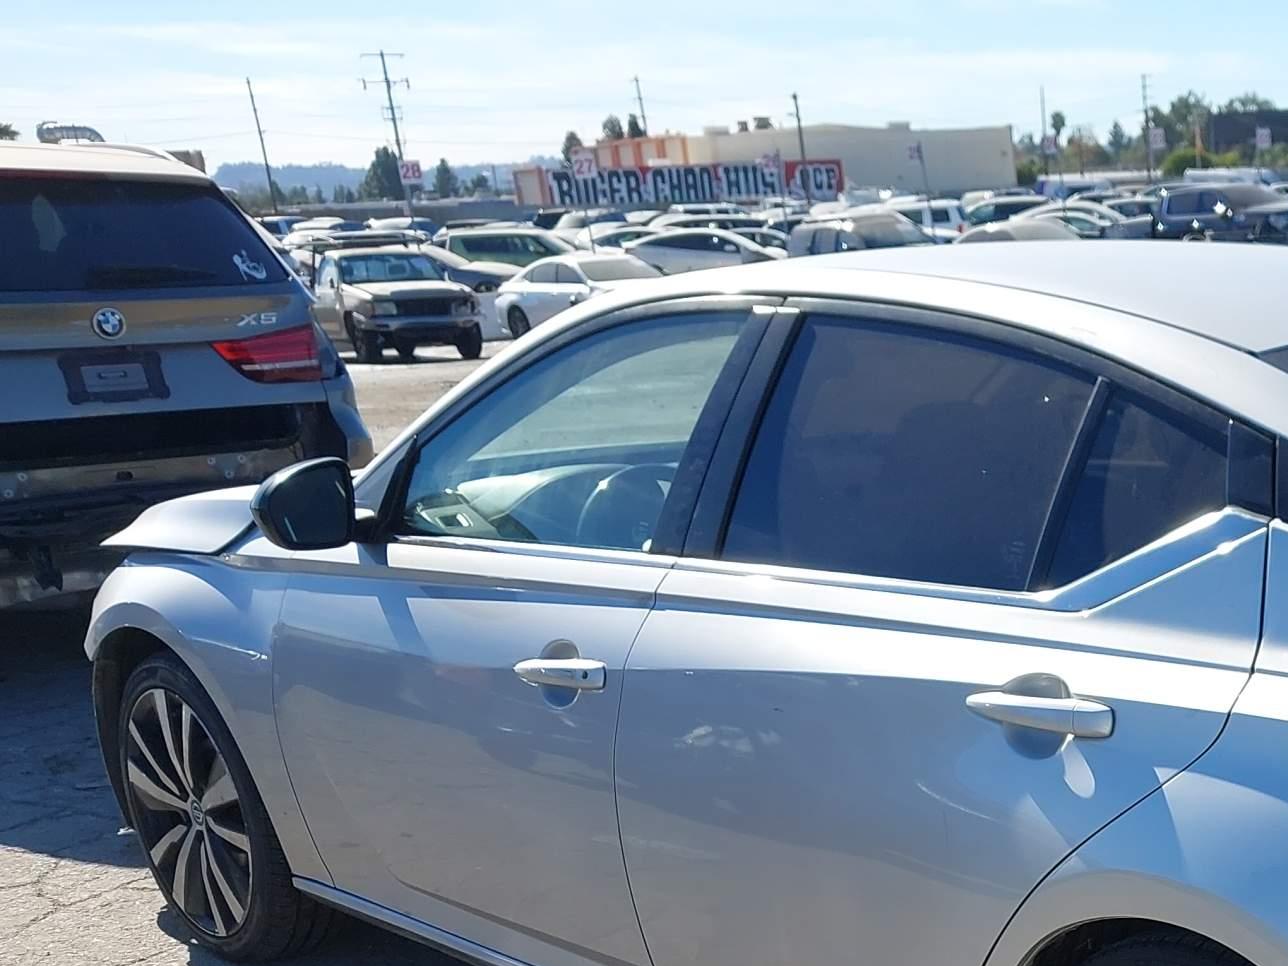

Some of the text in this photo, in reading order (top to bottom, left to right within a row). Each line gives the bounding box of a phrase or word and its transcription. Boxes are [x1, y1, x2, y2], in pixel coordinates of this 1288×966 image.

[401, 163, 422, 179] 28
[575, 159, 593, 174] 27
[237, 312, 277, 326] X5
